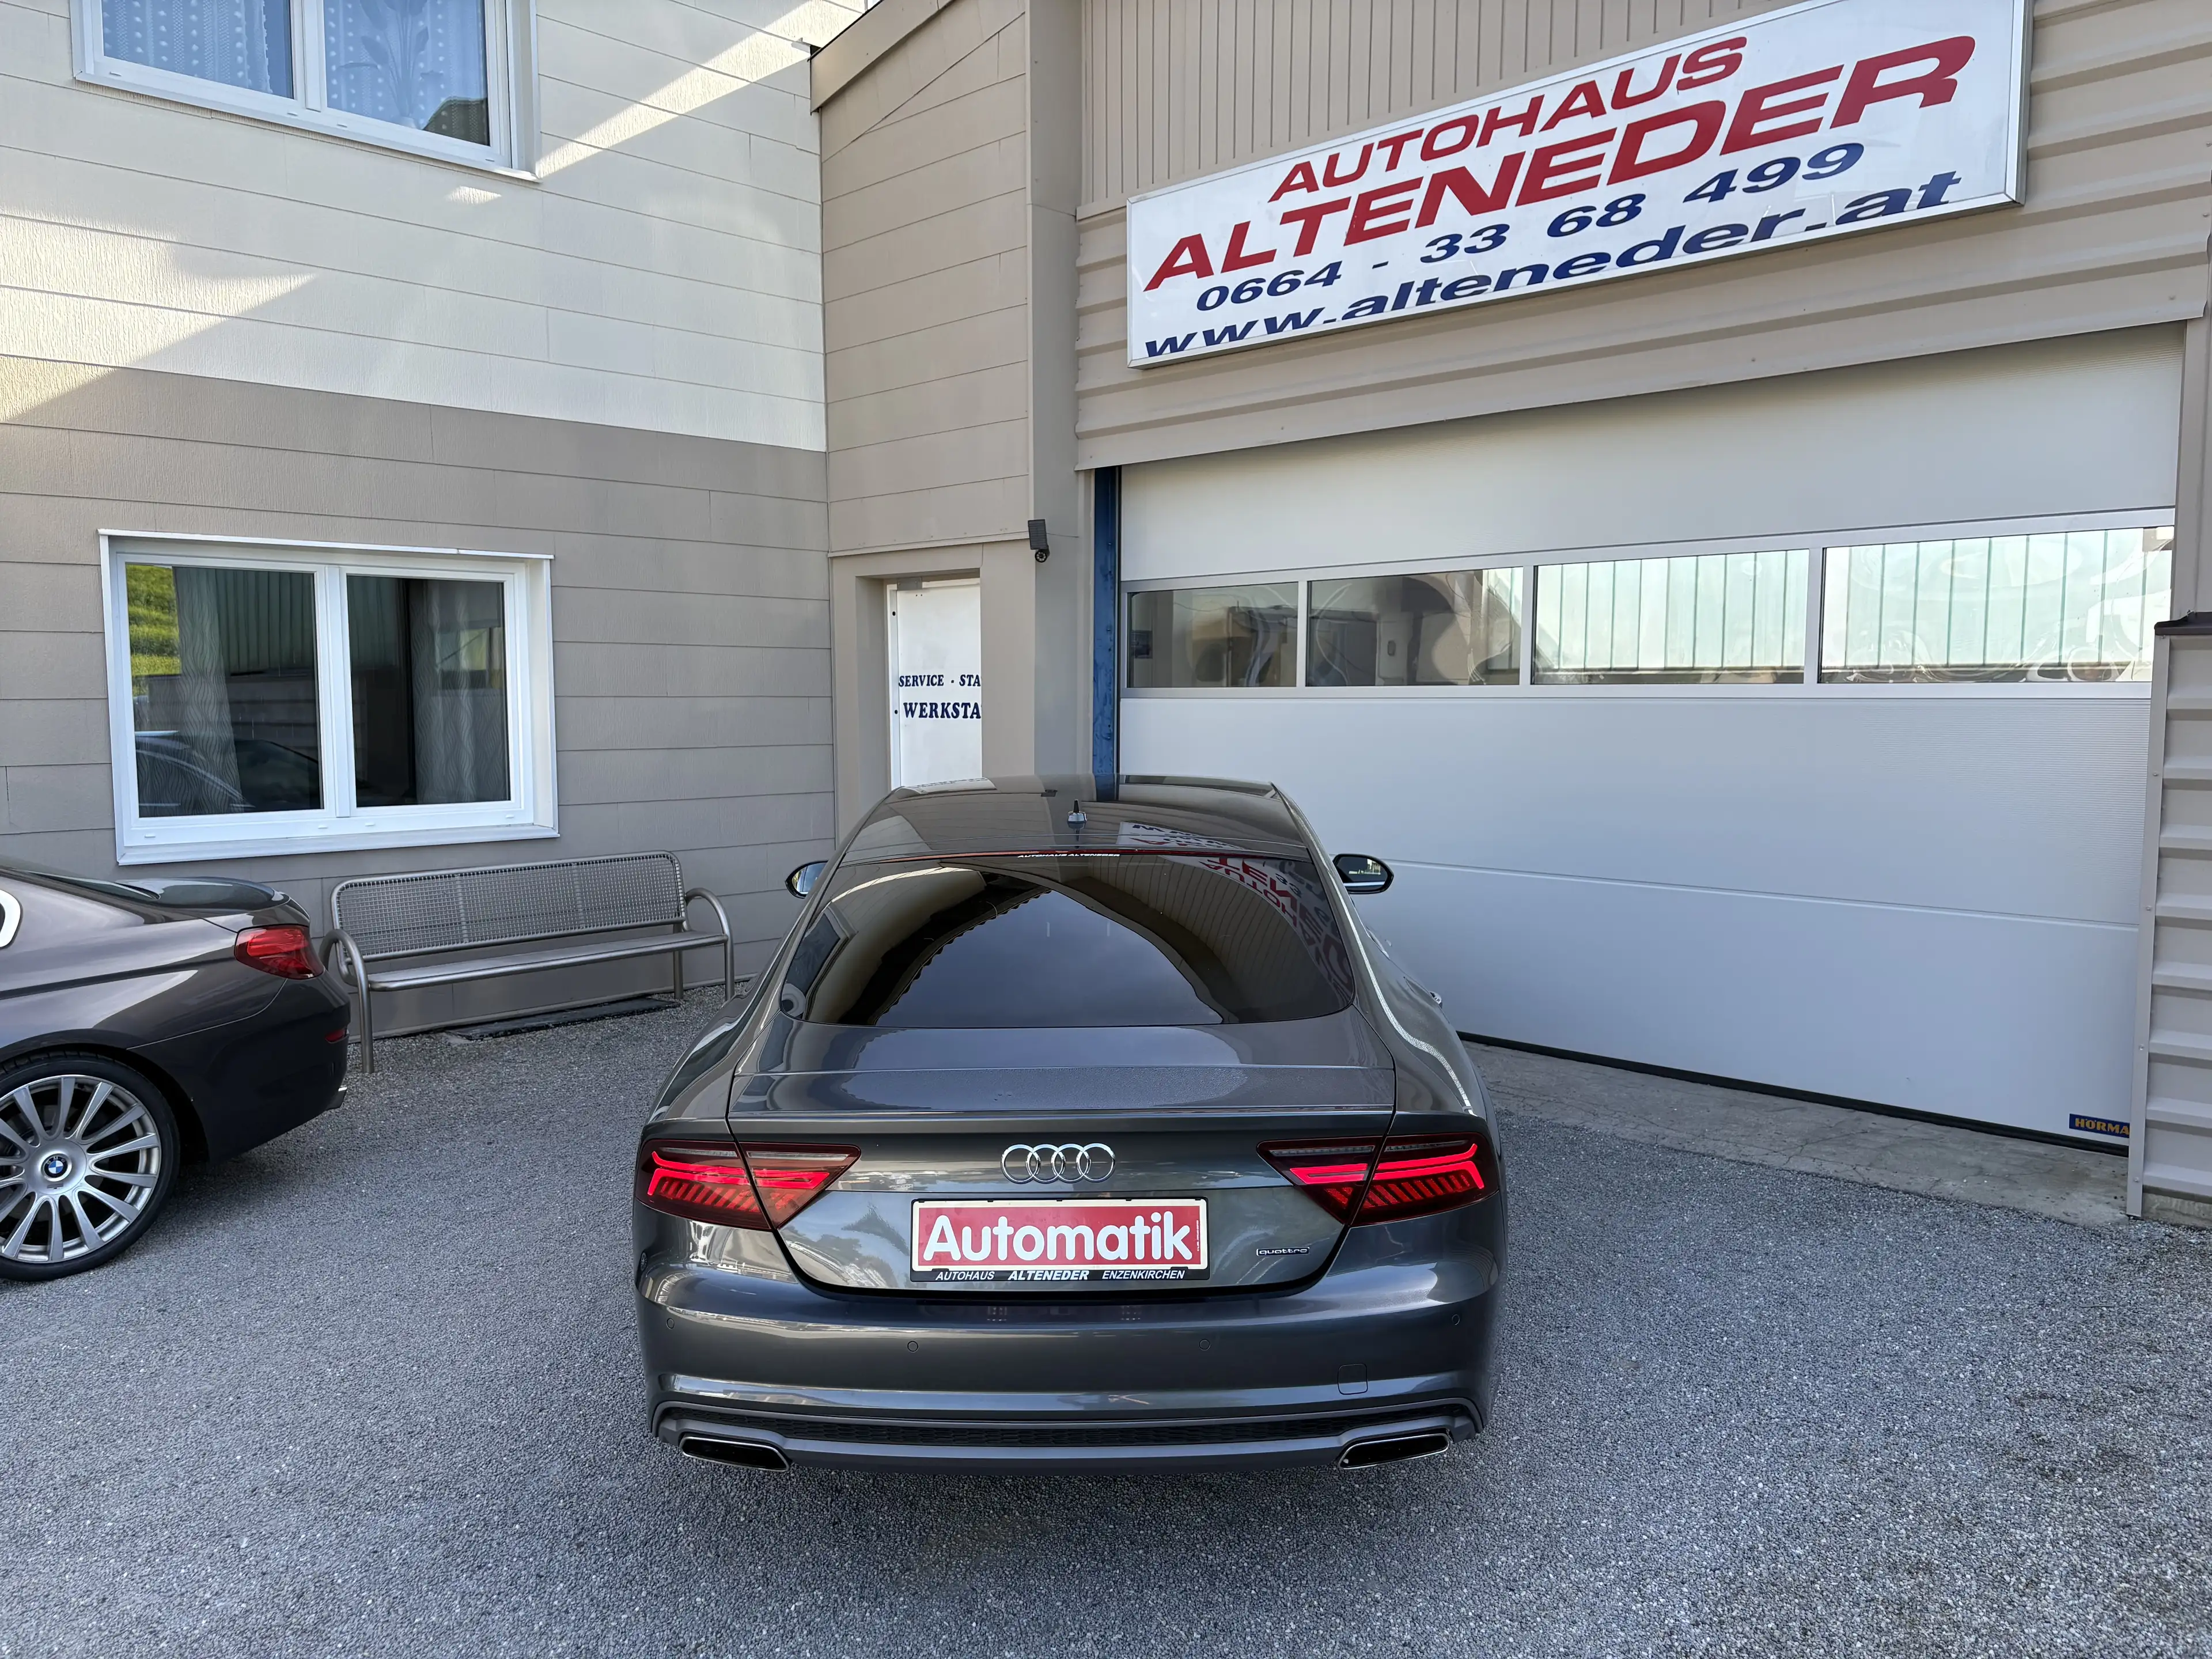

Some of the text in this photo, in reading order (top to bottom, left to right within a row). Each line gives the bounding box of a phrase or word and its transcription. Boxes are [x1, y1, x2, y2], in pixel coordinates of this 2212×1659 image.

[1143, 35, 1976, 293] ALTENEDER
[1270, 36, 1747, 202] AUTOHAUS
[1145, 171, 1962, 358] www.alteneder.at
[1196, 260, 1343, 312] 0664
[1419, 223, 1510, 264] 33
[1547, 193, 1647, 237] 68
[1682, 142, 1865, 203] 499
[899, 674, 981, 687] SERVICE STA
[903, 702, 981, 719] WERKSTA
[923, 1210, 1193, 1261] Automatik
[935, 1270, 1185, 1281] AUTOHAUS ALTENEDER ENZENKIRCHEN
